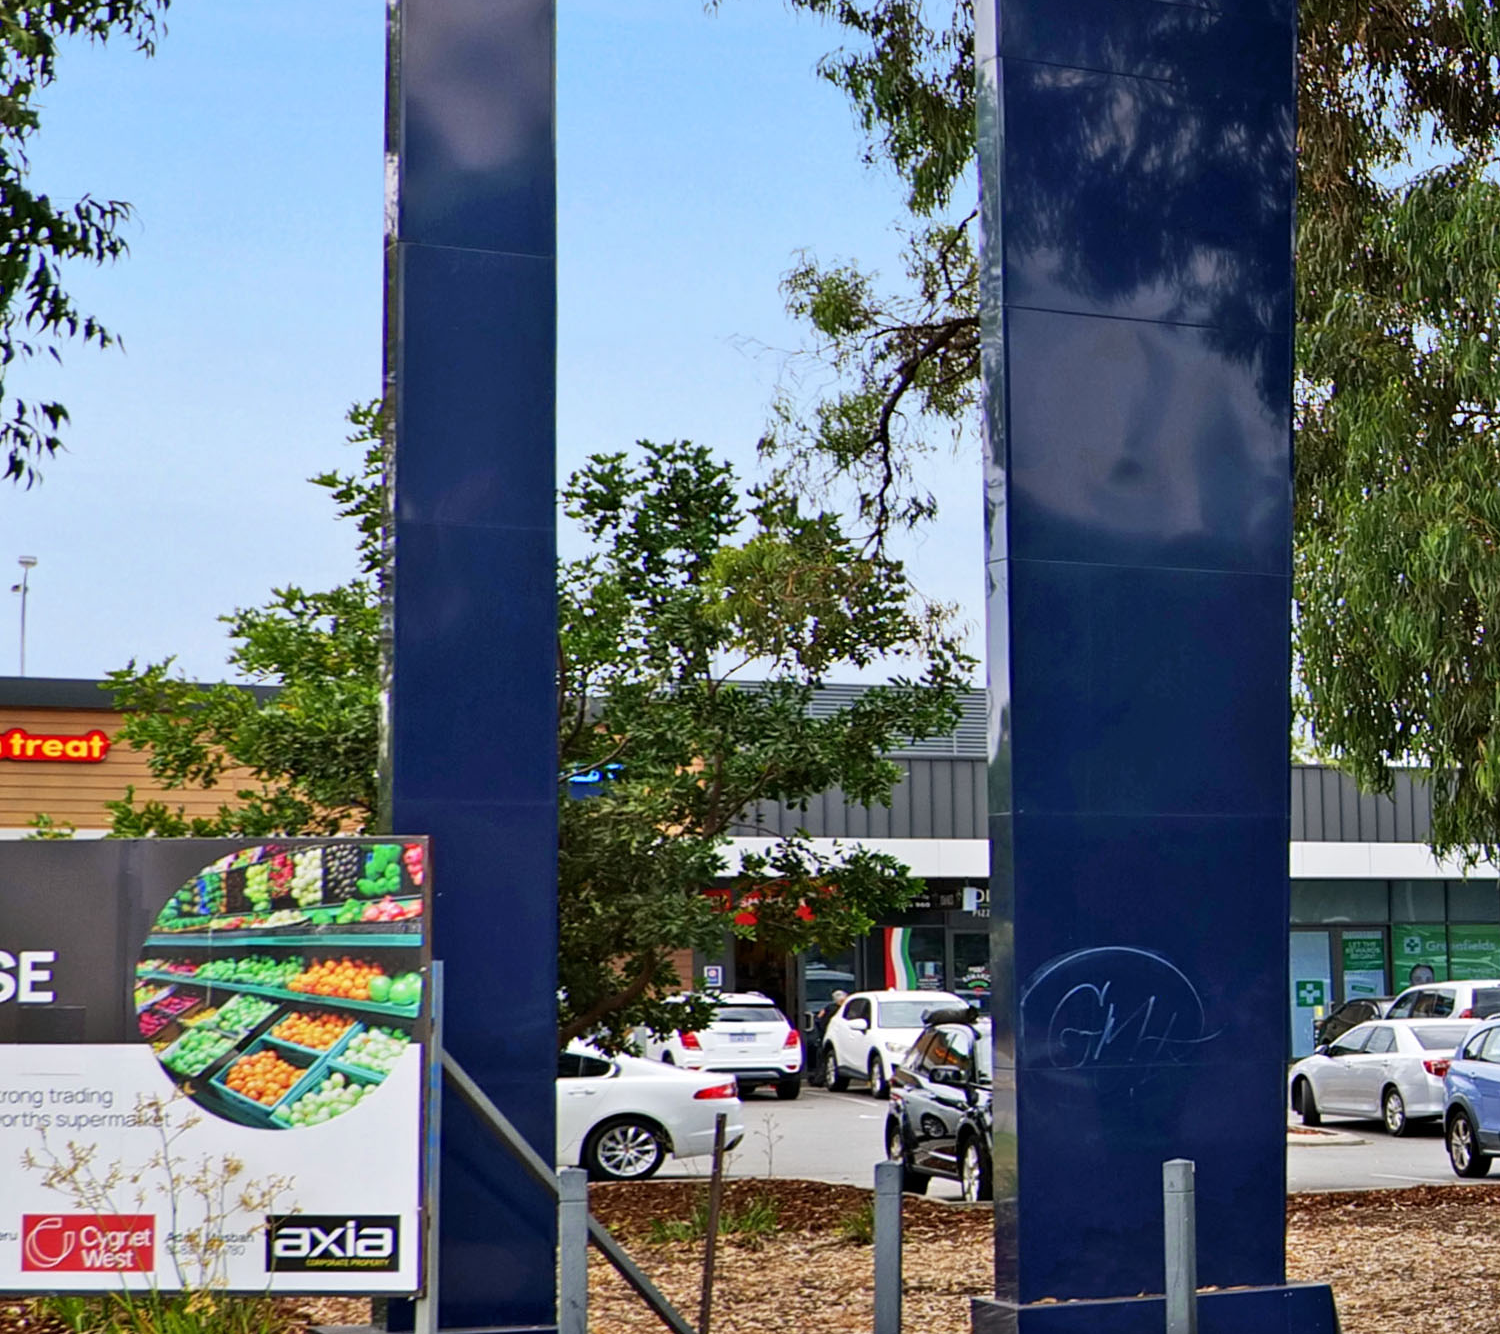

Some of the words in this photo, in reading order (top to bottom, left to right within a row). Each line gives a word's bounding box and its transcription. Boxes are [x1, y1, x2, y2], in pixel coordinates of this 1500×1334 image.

[9, 733, 104, 758] treat
[49, 1087, 114, 1109] trading
[0, 1111, 52, 1128] orths
[56, 1110, 171, 1132] supermarket
[80, 1225, 153, 1250] Cygnet
[273, 1220, 394, 1258] axia
[81, 1249, 134, 1268] West
[305, 1258, 349, 1267] CORPORATE
[350, 1258, 390, 1267] PROPERTY
